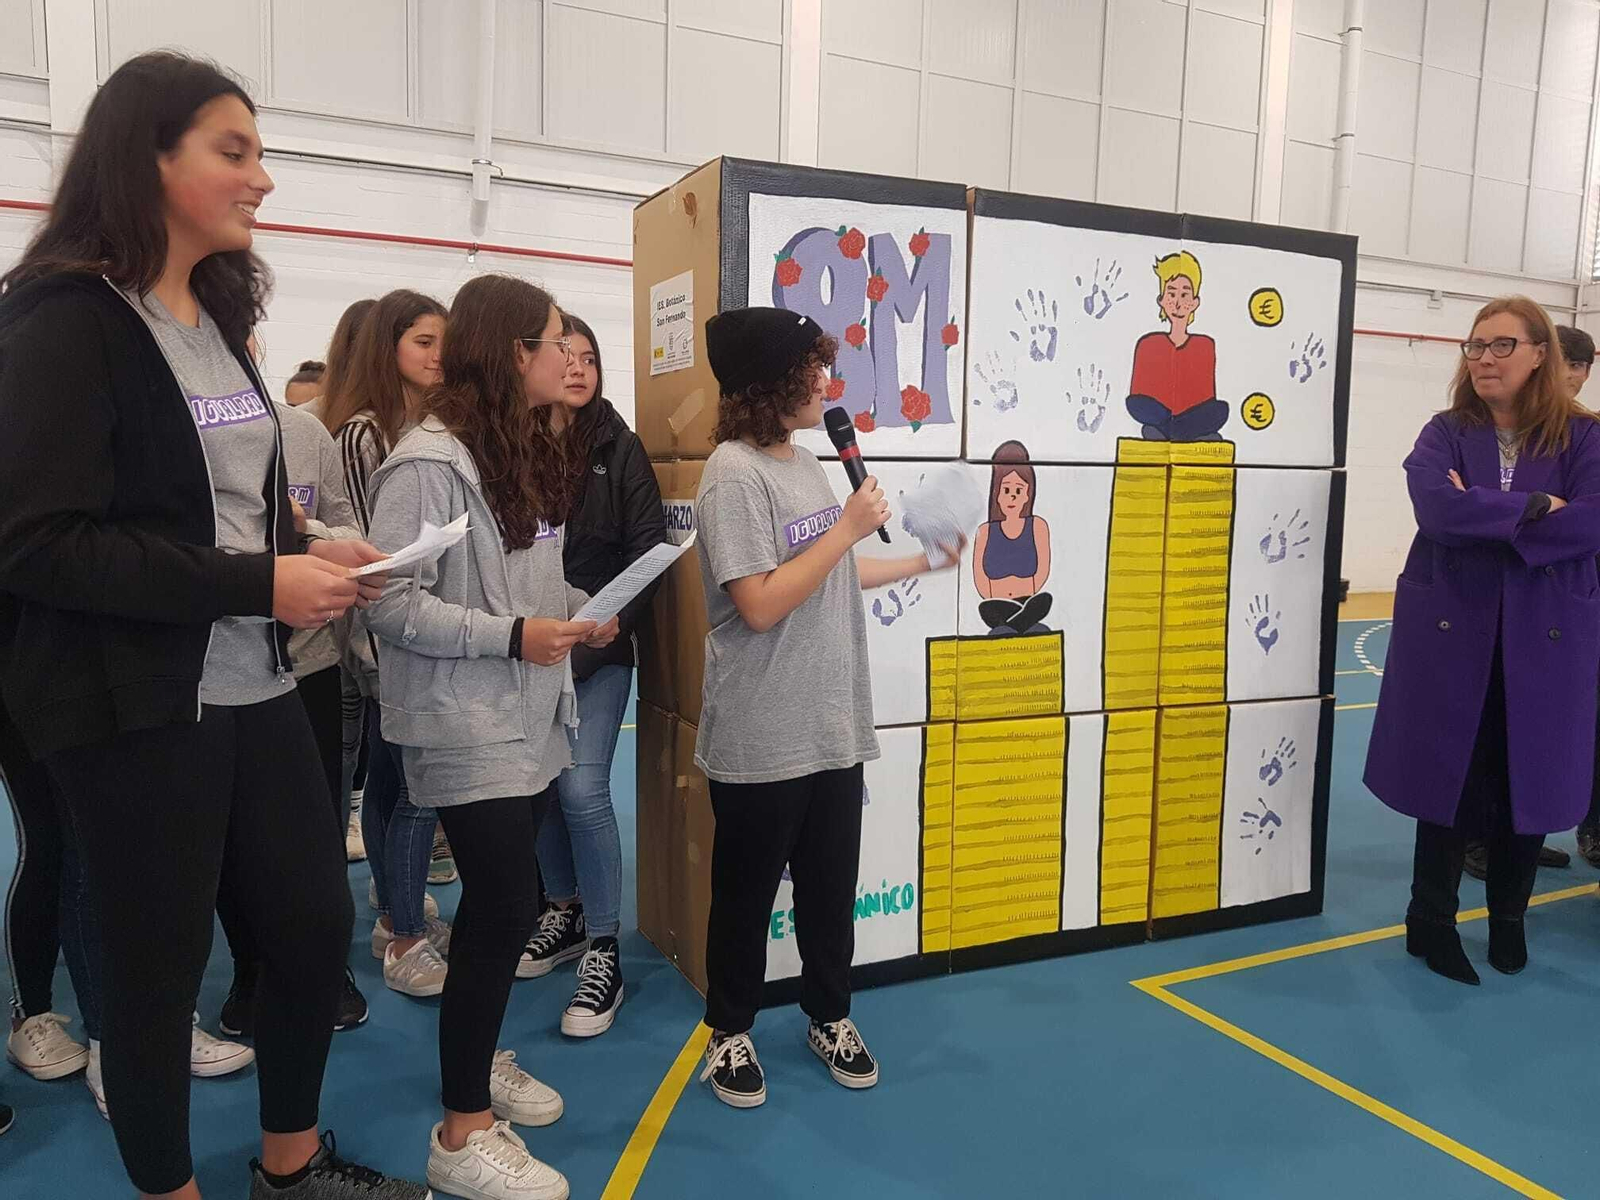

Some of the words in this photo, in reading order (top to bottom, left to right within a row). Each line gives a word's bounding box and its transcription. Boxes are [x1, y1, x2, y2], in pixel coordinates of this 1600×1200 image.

[657, 317, 665, 326] San
[666, 310, 686, 323] Fernando
[192, 392, 266, 425] IGUALDAD
[853, 879, 915, 921] ÁNICO
